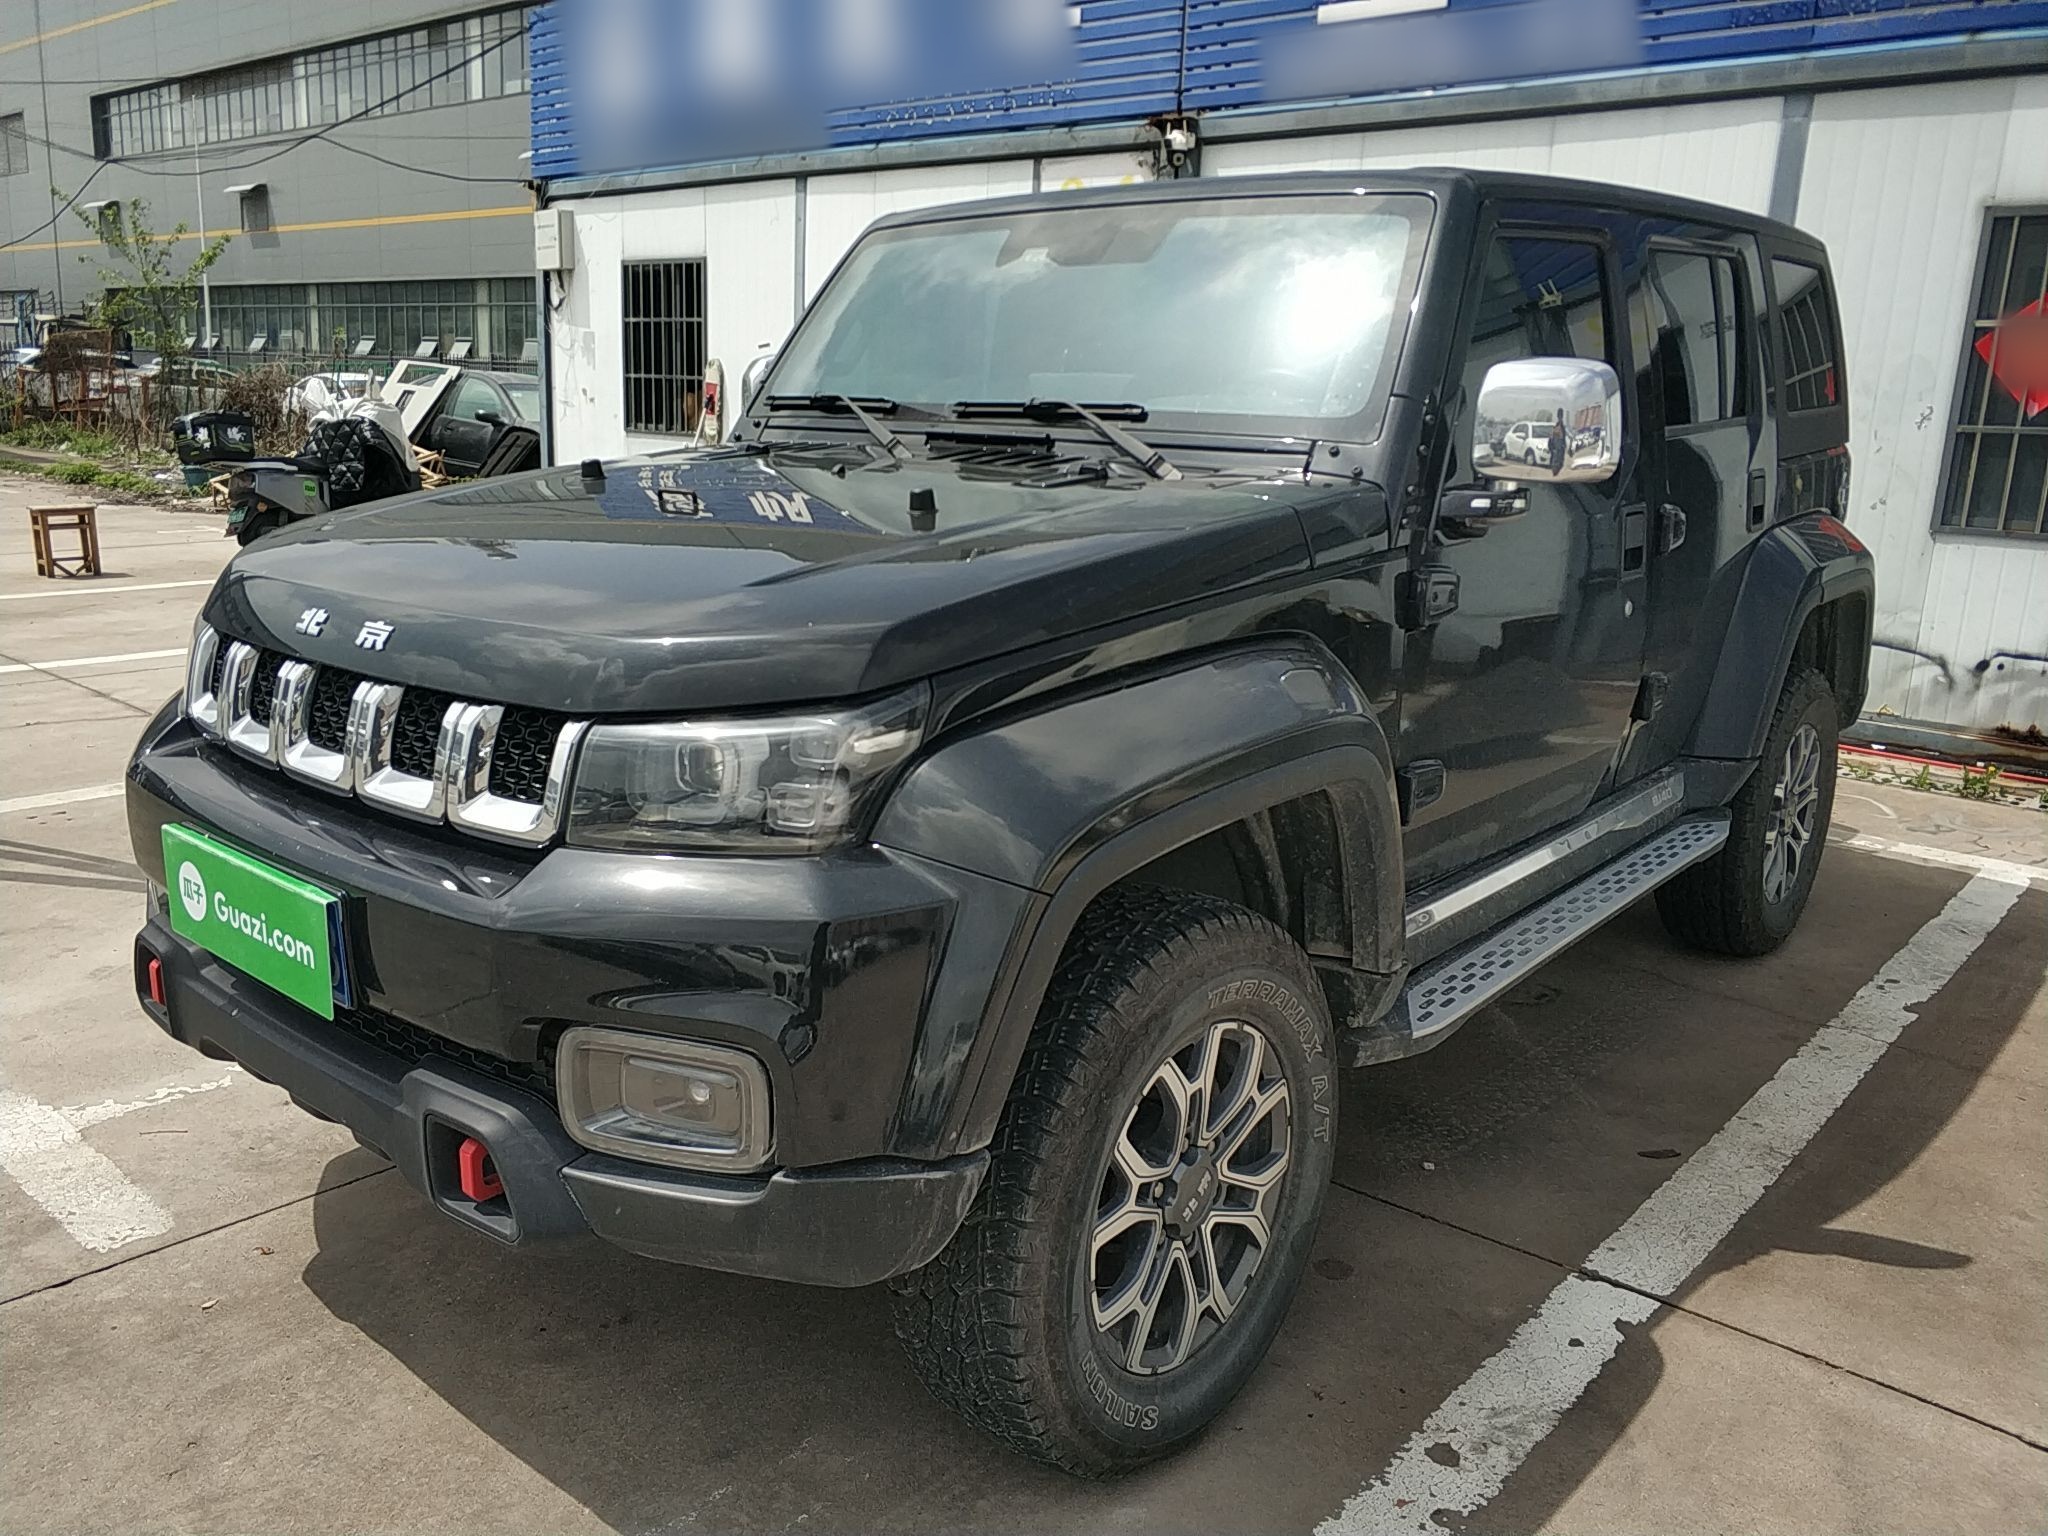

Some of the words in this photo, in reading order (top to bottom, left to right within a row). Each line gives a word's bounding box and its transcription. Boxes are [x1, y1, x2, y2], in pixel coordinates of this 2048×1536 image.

[295, 607, 395, 651] 北京
[183, 876, 203, 906] 瓜子
[214, 891, 315, 971] Guazi.com
[1208, 980, 1323, 1062] TERRAMAX
[1311, 1075, 1330, 1143] A/T
[1082, 1351, 1158, 1431] SAILUN
